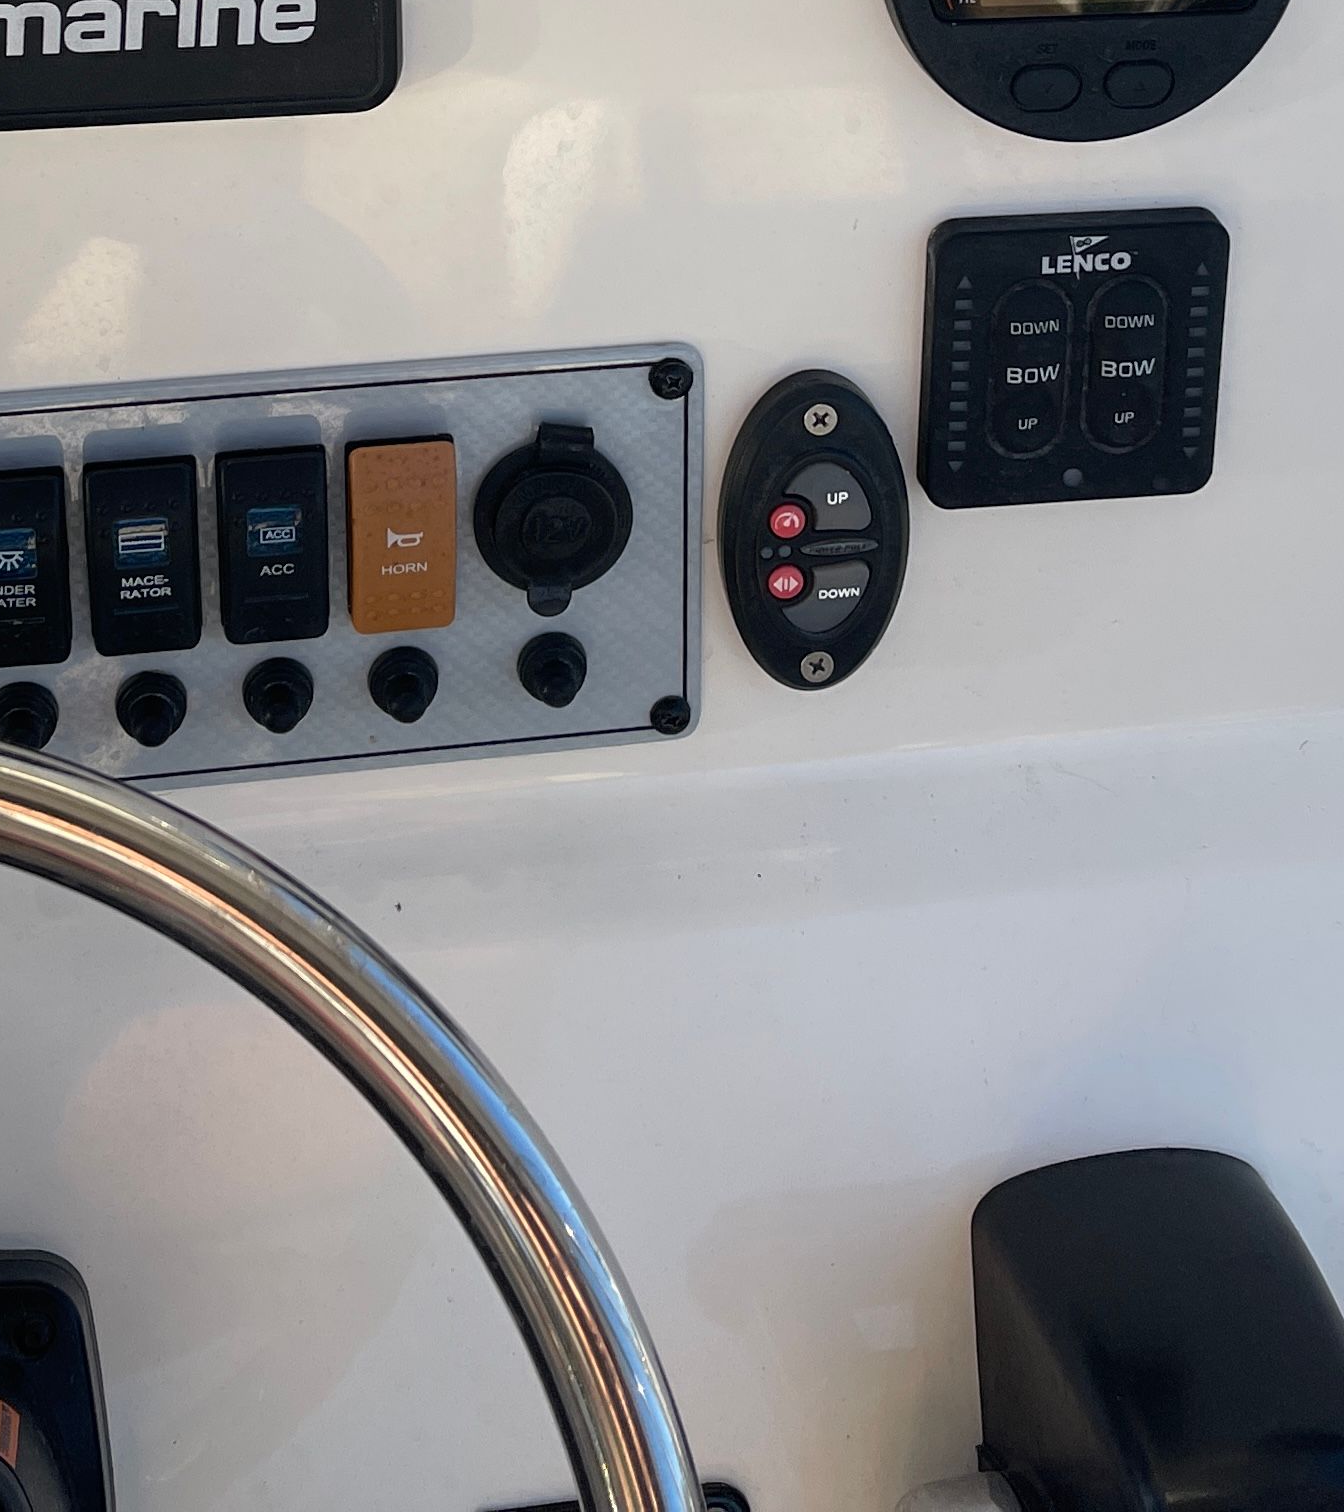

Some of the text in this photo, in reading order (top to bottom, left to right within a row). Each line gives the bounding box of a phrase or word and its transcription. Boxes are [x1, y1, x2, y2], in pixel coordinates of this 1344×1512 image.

[1041, 251, 1132, 274] LENCO
[1010, 319, 1060, 336] DOWN
[1104, 314, 1155, 330] DOWN
[1006, 363, 1060, 385] BOW
[1101, 357, 1156, 379] BOW
[1018, 417, 1038, 431] UP
[1114, 411, 1135, 425] UP
[827, 491, 849, 505] UP
[265, 529, 291, 539] ACC
[260, 564, 295, 577] ACC
[381, 562, 428, 576] HORN
[121, 576, 169, 588] MACE-
[120, 586, 172, 599] RATOR
[818, 587, 860, 600] DOWN
